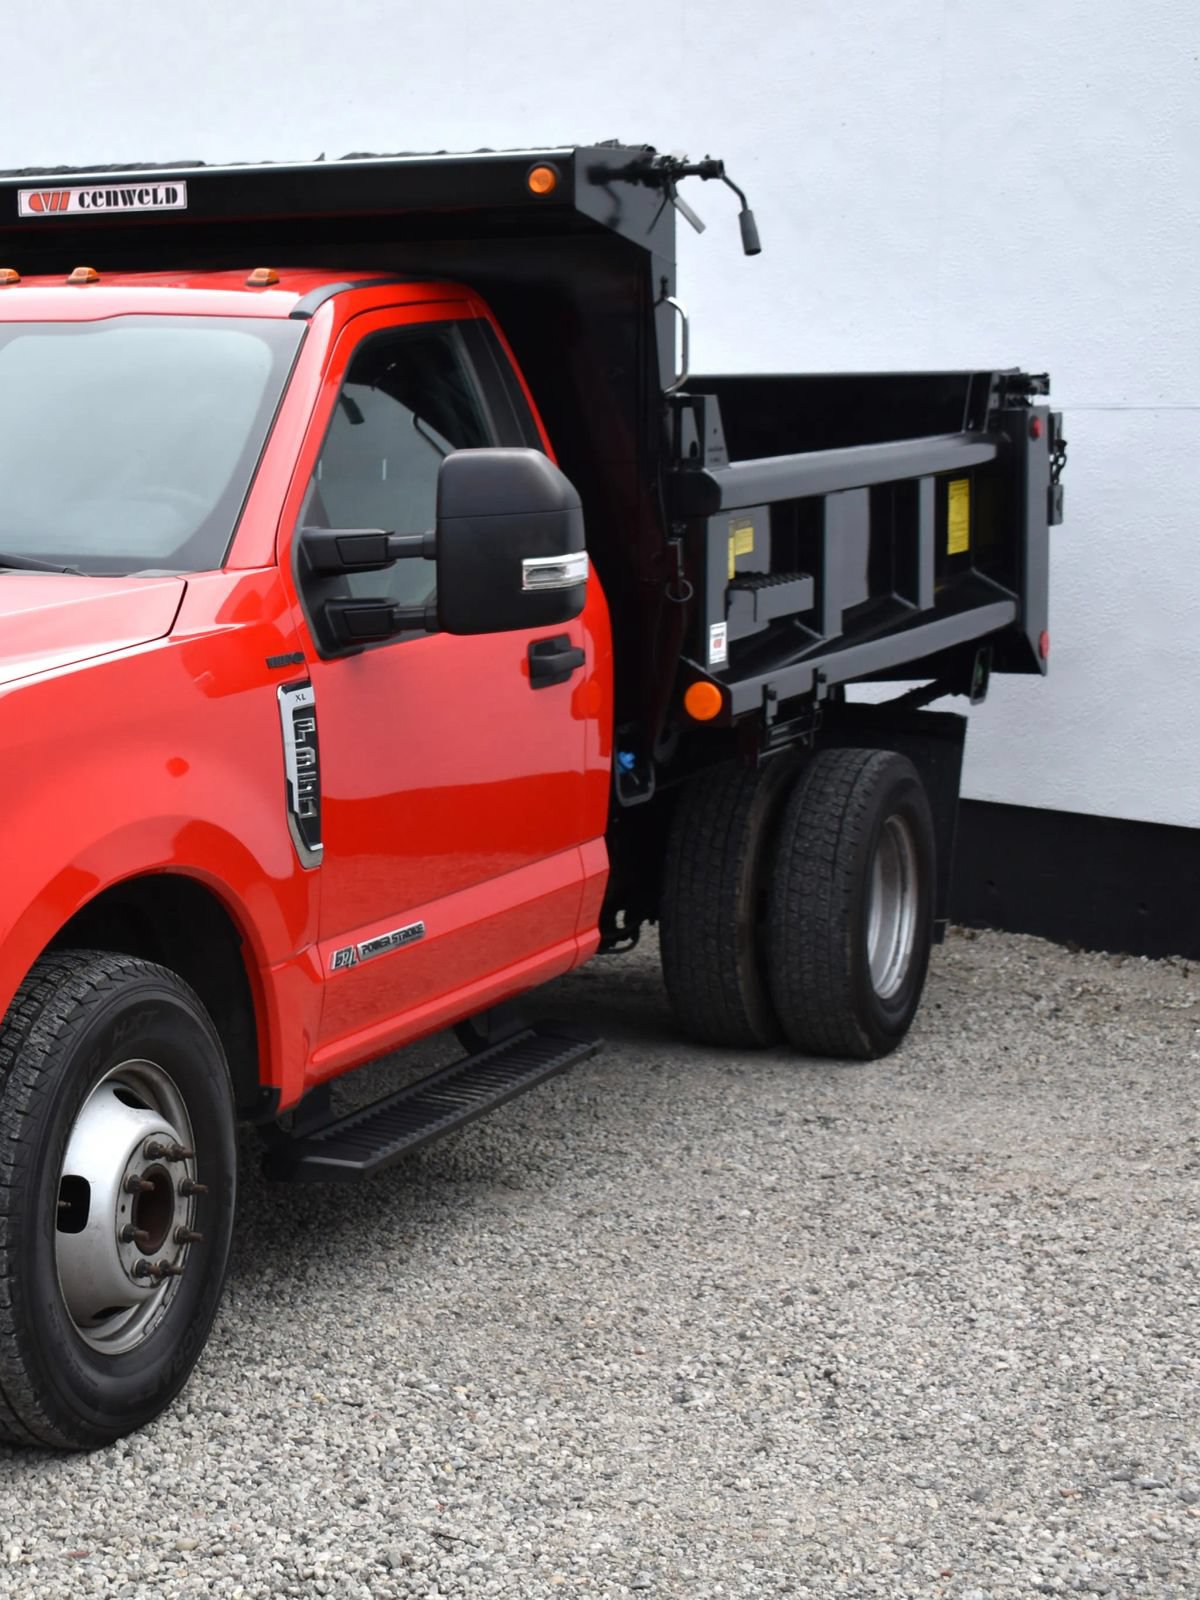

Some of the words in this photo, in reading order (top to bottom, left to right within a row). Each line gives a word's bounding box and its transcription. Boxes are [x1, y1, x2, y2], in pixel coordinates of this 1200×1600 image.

[295, 693, 307, 702] XL
[360, 935, 392, 957] POWER
[391, 922, 424, 945] STROKE
